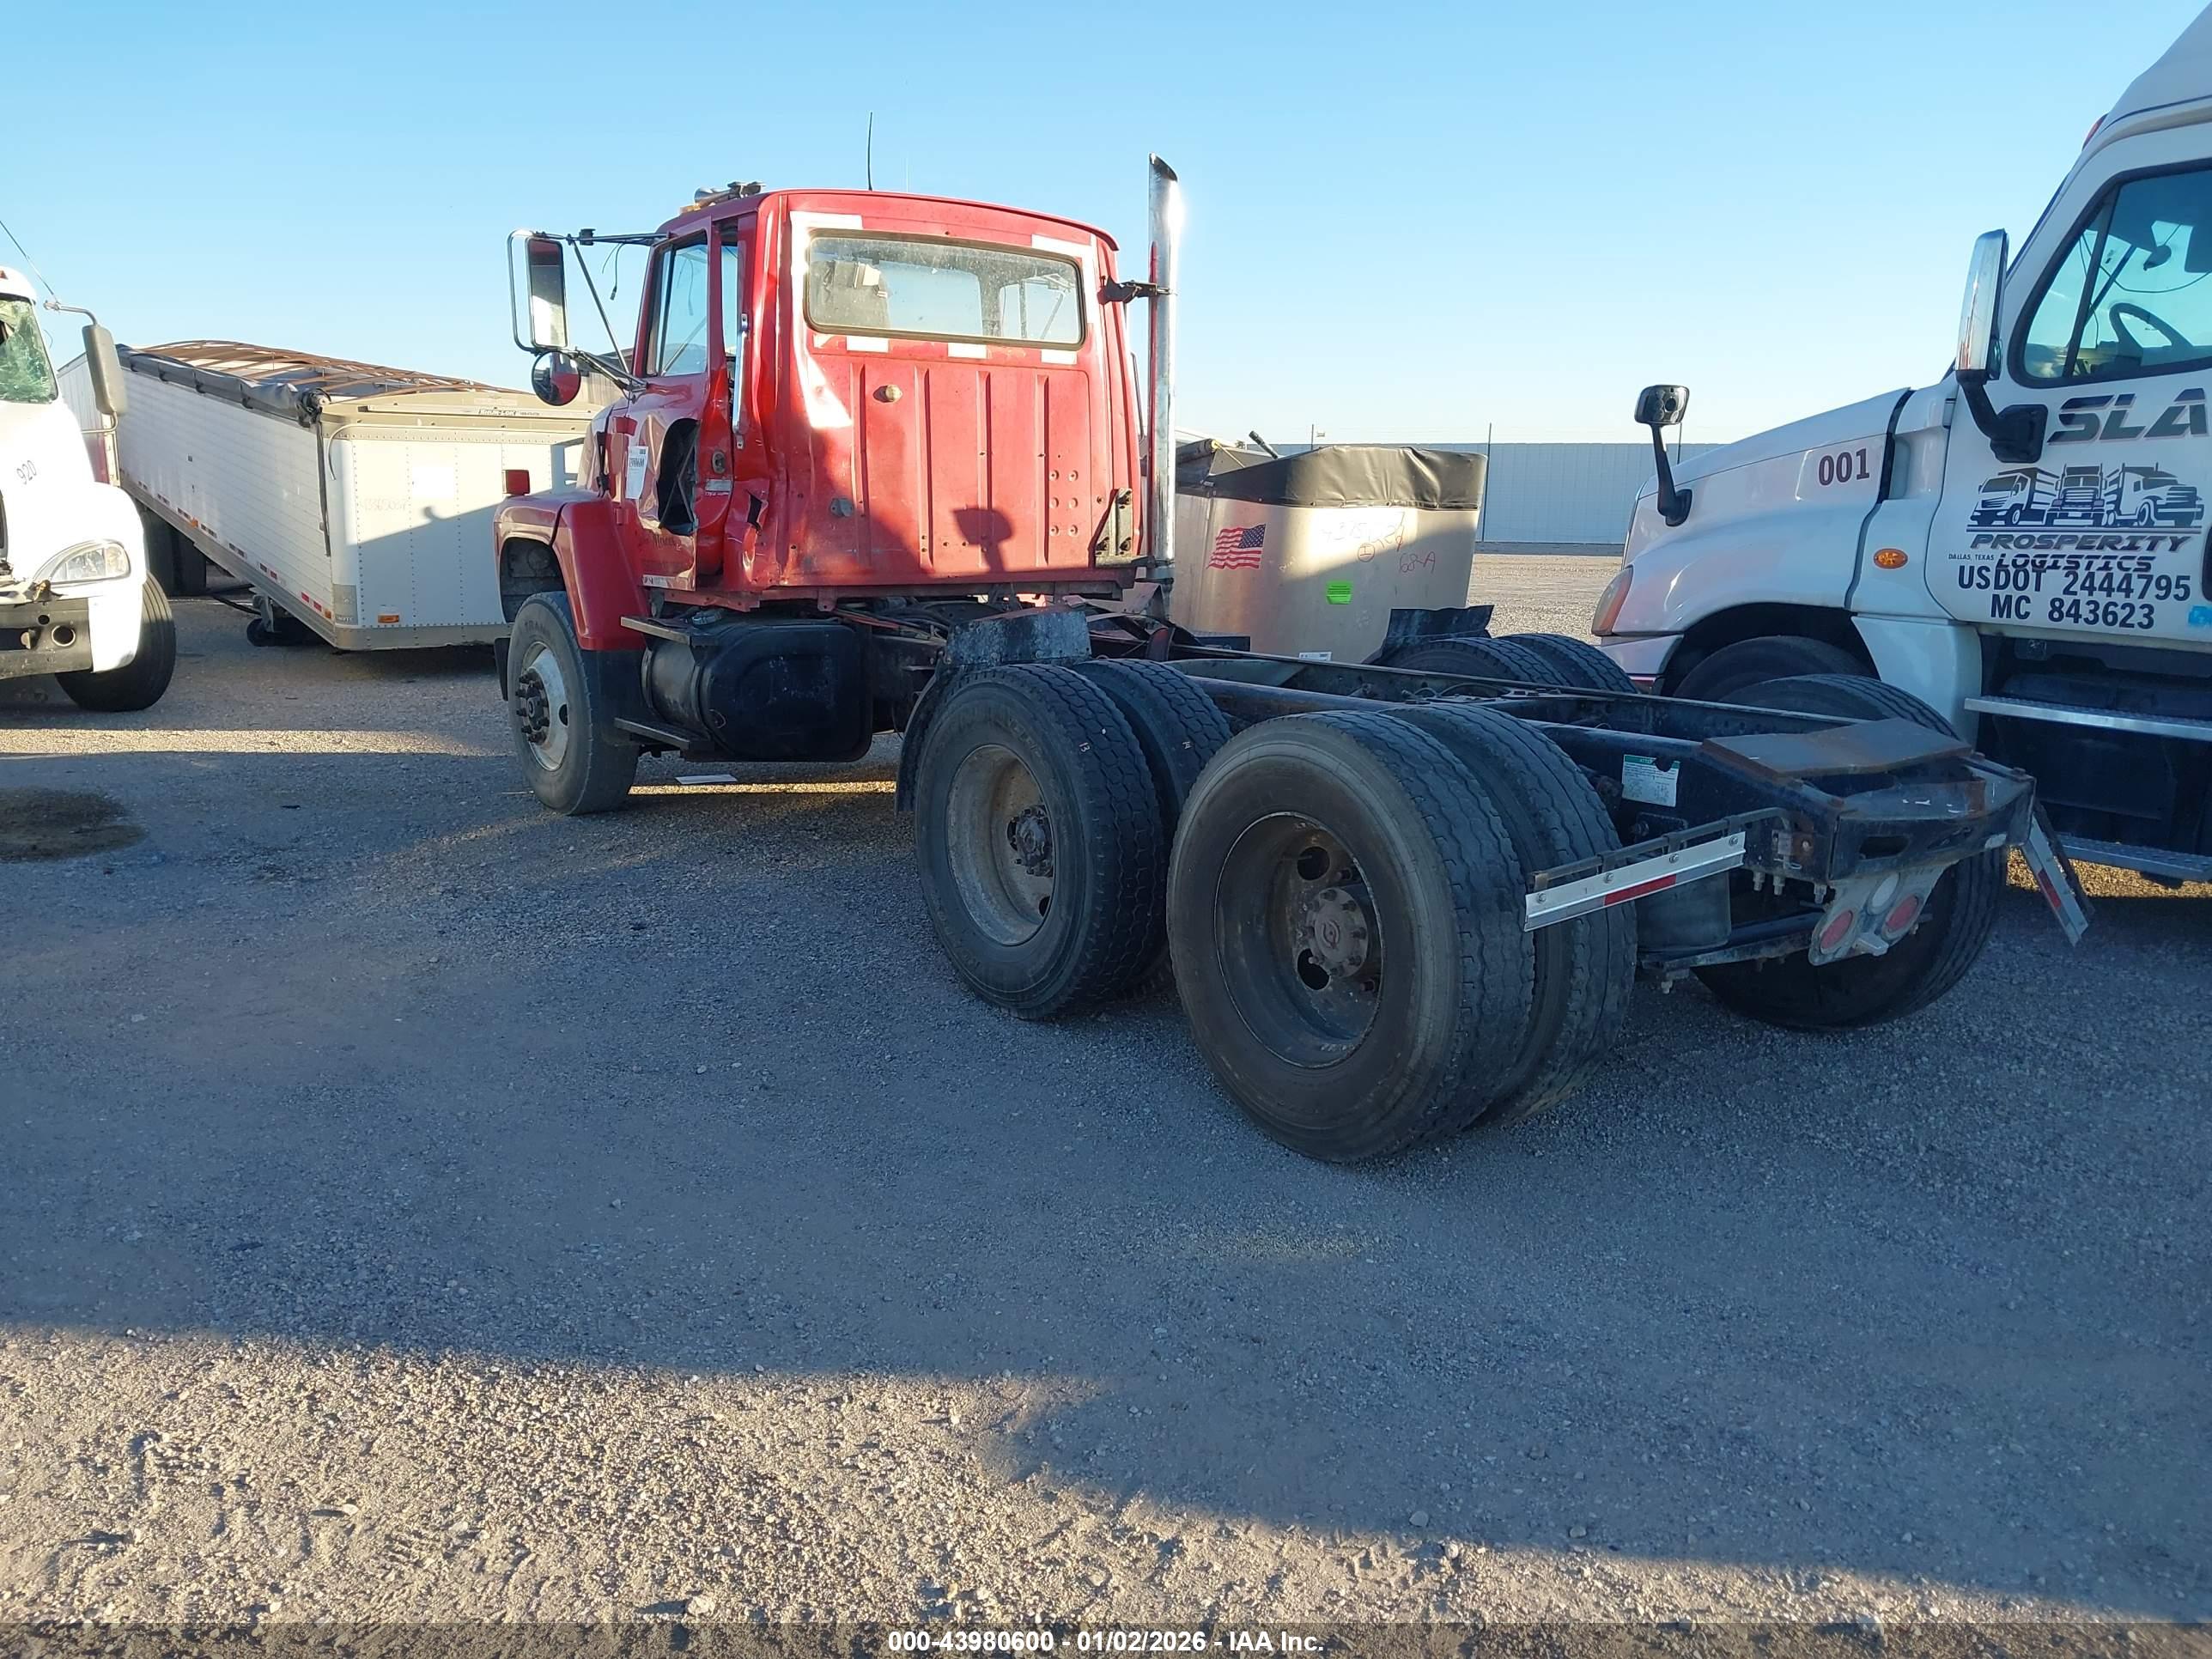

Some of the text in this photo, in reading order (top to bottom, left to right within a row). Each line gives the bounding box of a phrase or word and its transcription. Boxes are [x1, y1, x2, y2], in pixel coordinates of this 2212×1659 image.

[2047, 388, 2208, 444] SLA
[16, 459, 37, 485] 920
[1818, 447, 1870, 486] 001
[1970, 533, 2191, 552] PROSPERITY
[1995, 553, 2156, 573] LOGISTICS
[1958, 565, 2191, 601] USDOT 2444795
[1990, 594, 2155, 629] MC 843623
